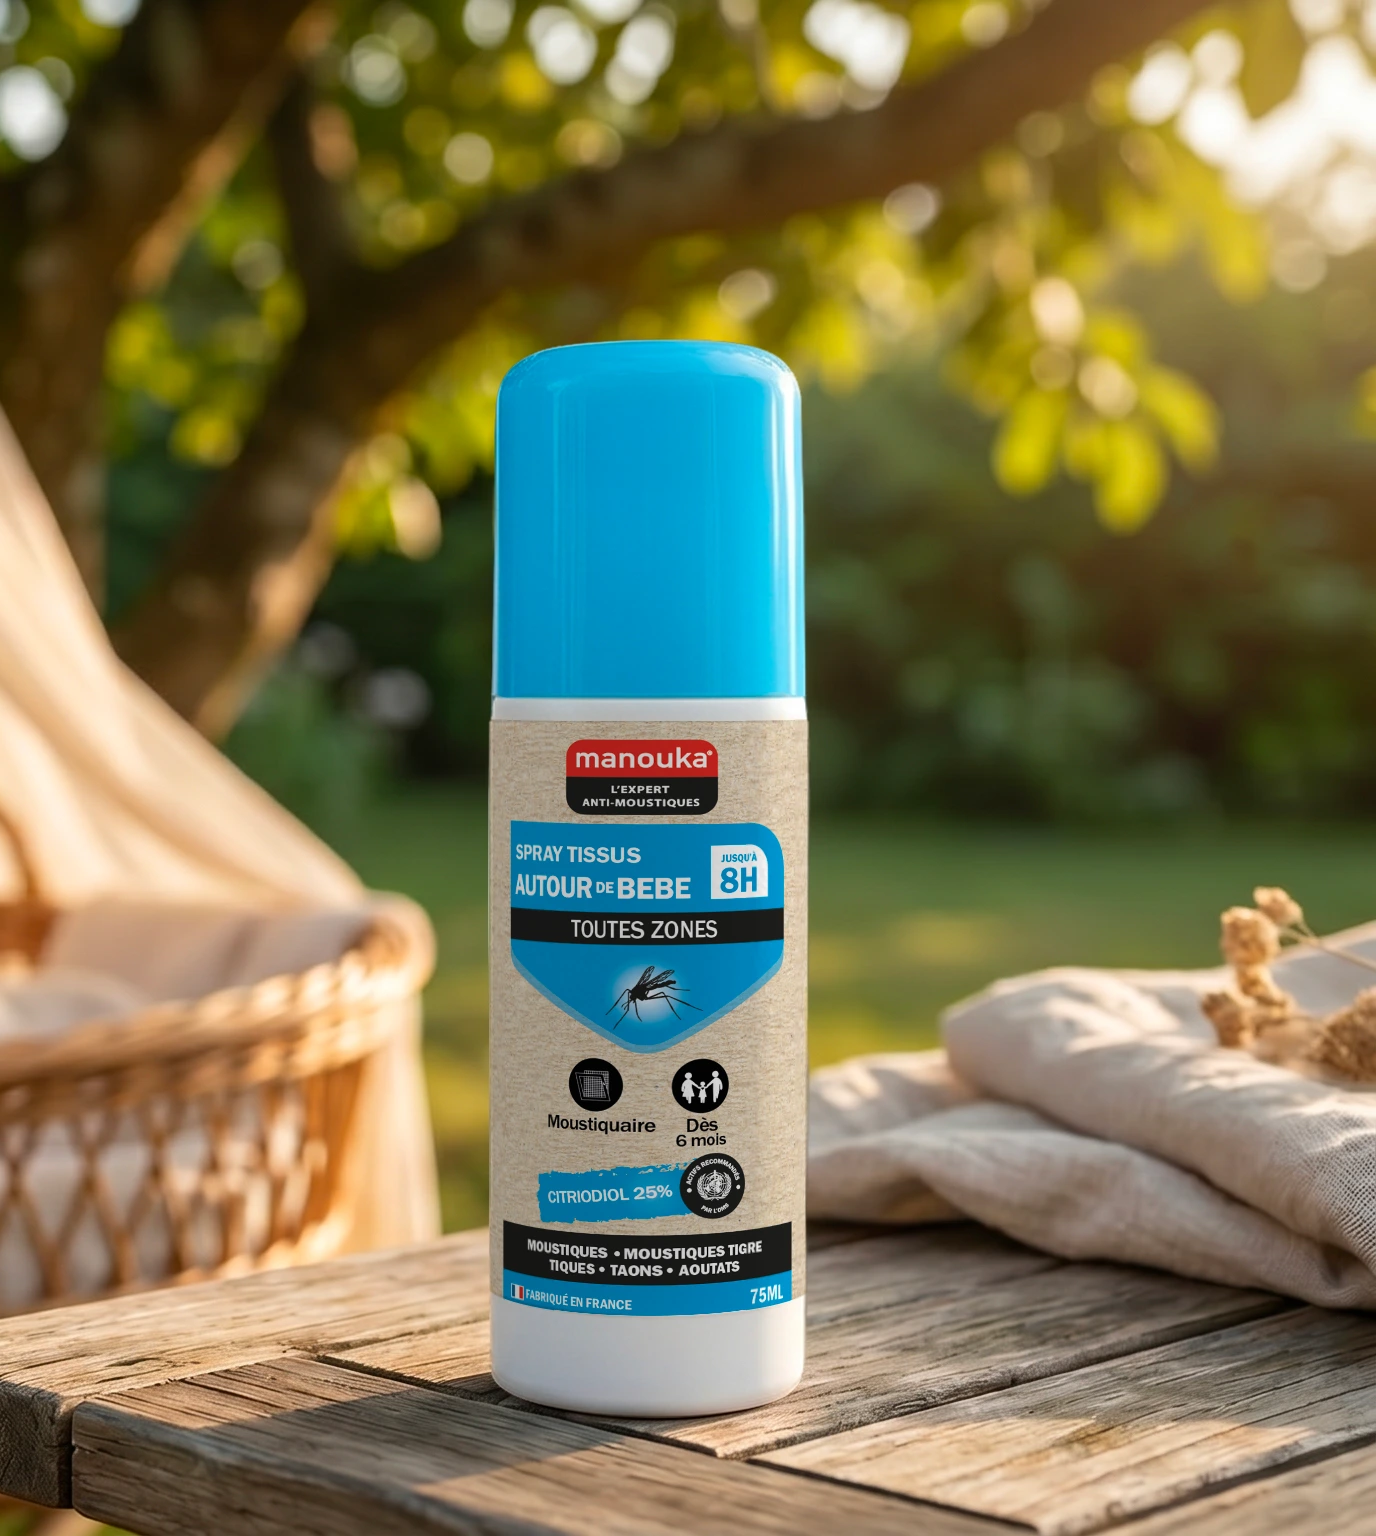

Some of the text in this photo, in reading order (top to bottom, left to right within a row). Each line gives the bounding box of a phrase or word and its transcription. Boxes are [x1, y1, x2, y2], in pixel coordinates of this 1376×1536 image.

[582, 797, 700, 809] ANTI-MOUSTIQUES
[515, 844, 641, 864] SPRAY TISSUS
[515, 873, 691, 900] AUTOUR DE BEBE
[720, 866, 758, 894] 8H
[571, 919, 718, 940] TOUTES ZONES
[547, 1113, 656, 1135] Moustiquaire
[686, 1117, 718, 1133] Dès
[675, 1133, 727, 1147] 6 mois
[686, 1165, 702, 1185] ACTIFS
[547, 1185, 673, 1204] CITRIODIOL 25%
[700, 1205, 712, 1214] PAR
[527, 1238, 763, 1261] MOUSTIQUES MOUSTIQUES TIGRE
[549, 1259, 740, 1277] TIQUES TAONS AOUTATS
[525, 1288, 633, 1311] FABRIQUÉ EN FRANCE
[750, 1287, 784, 1305] 75ML
